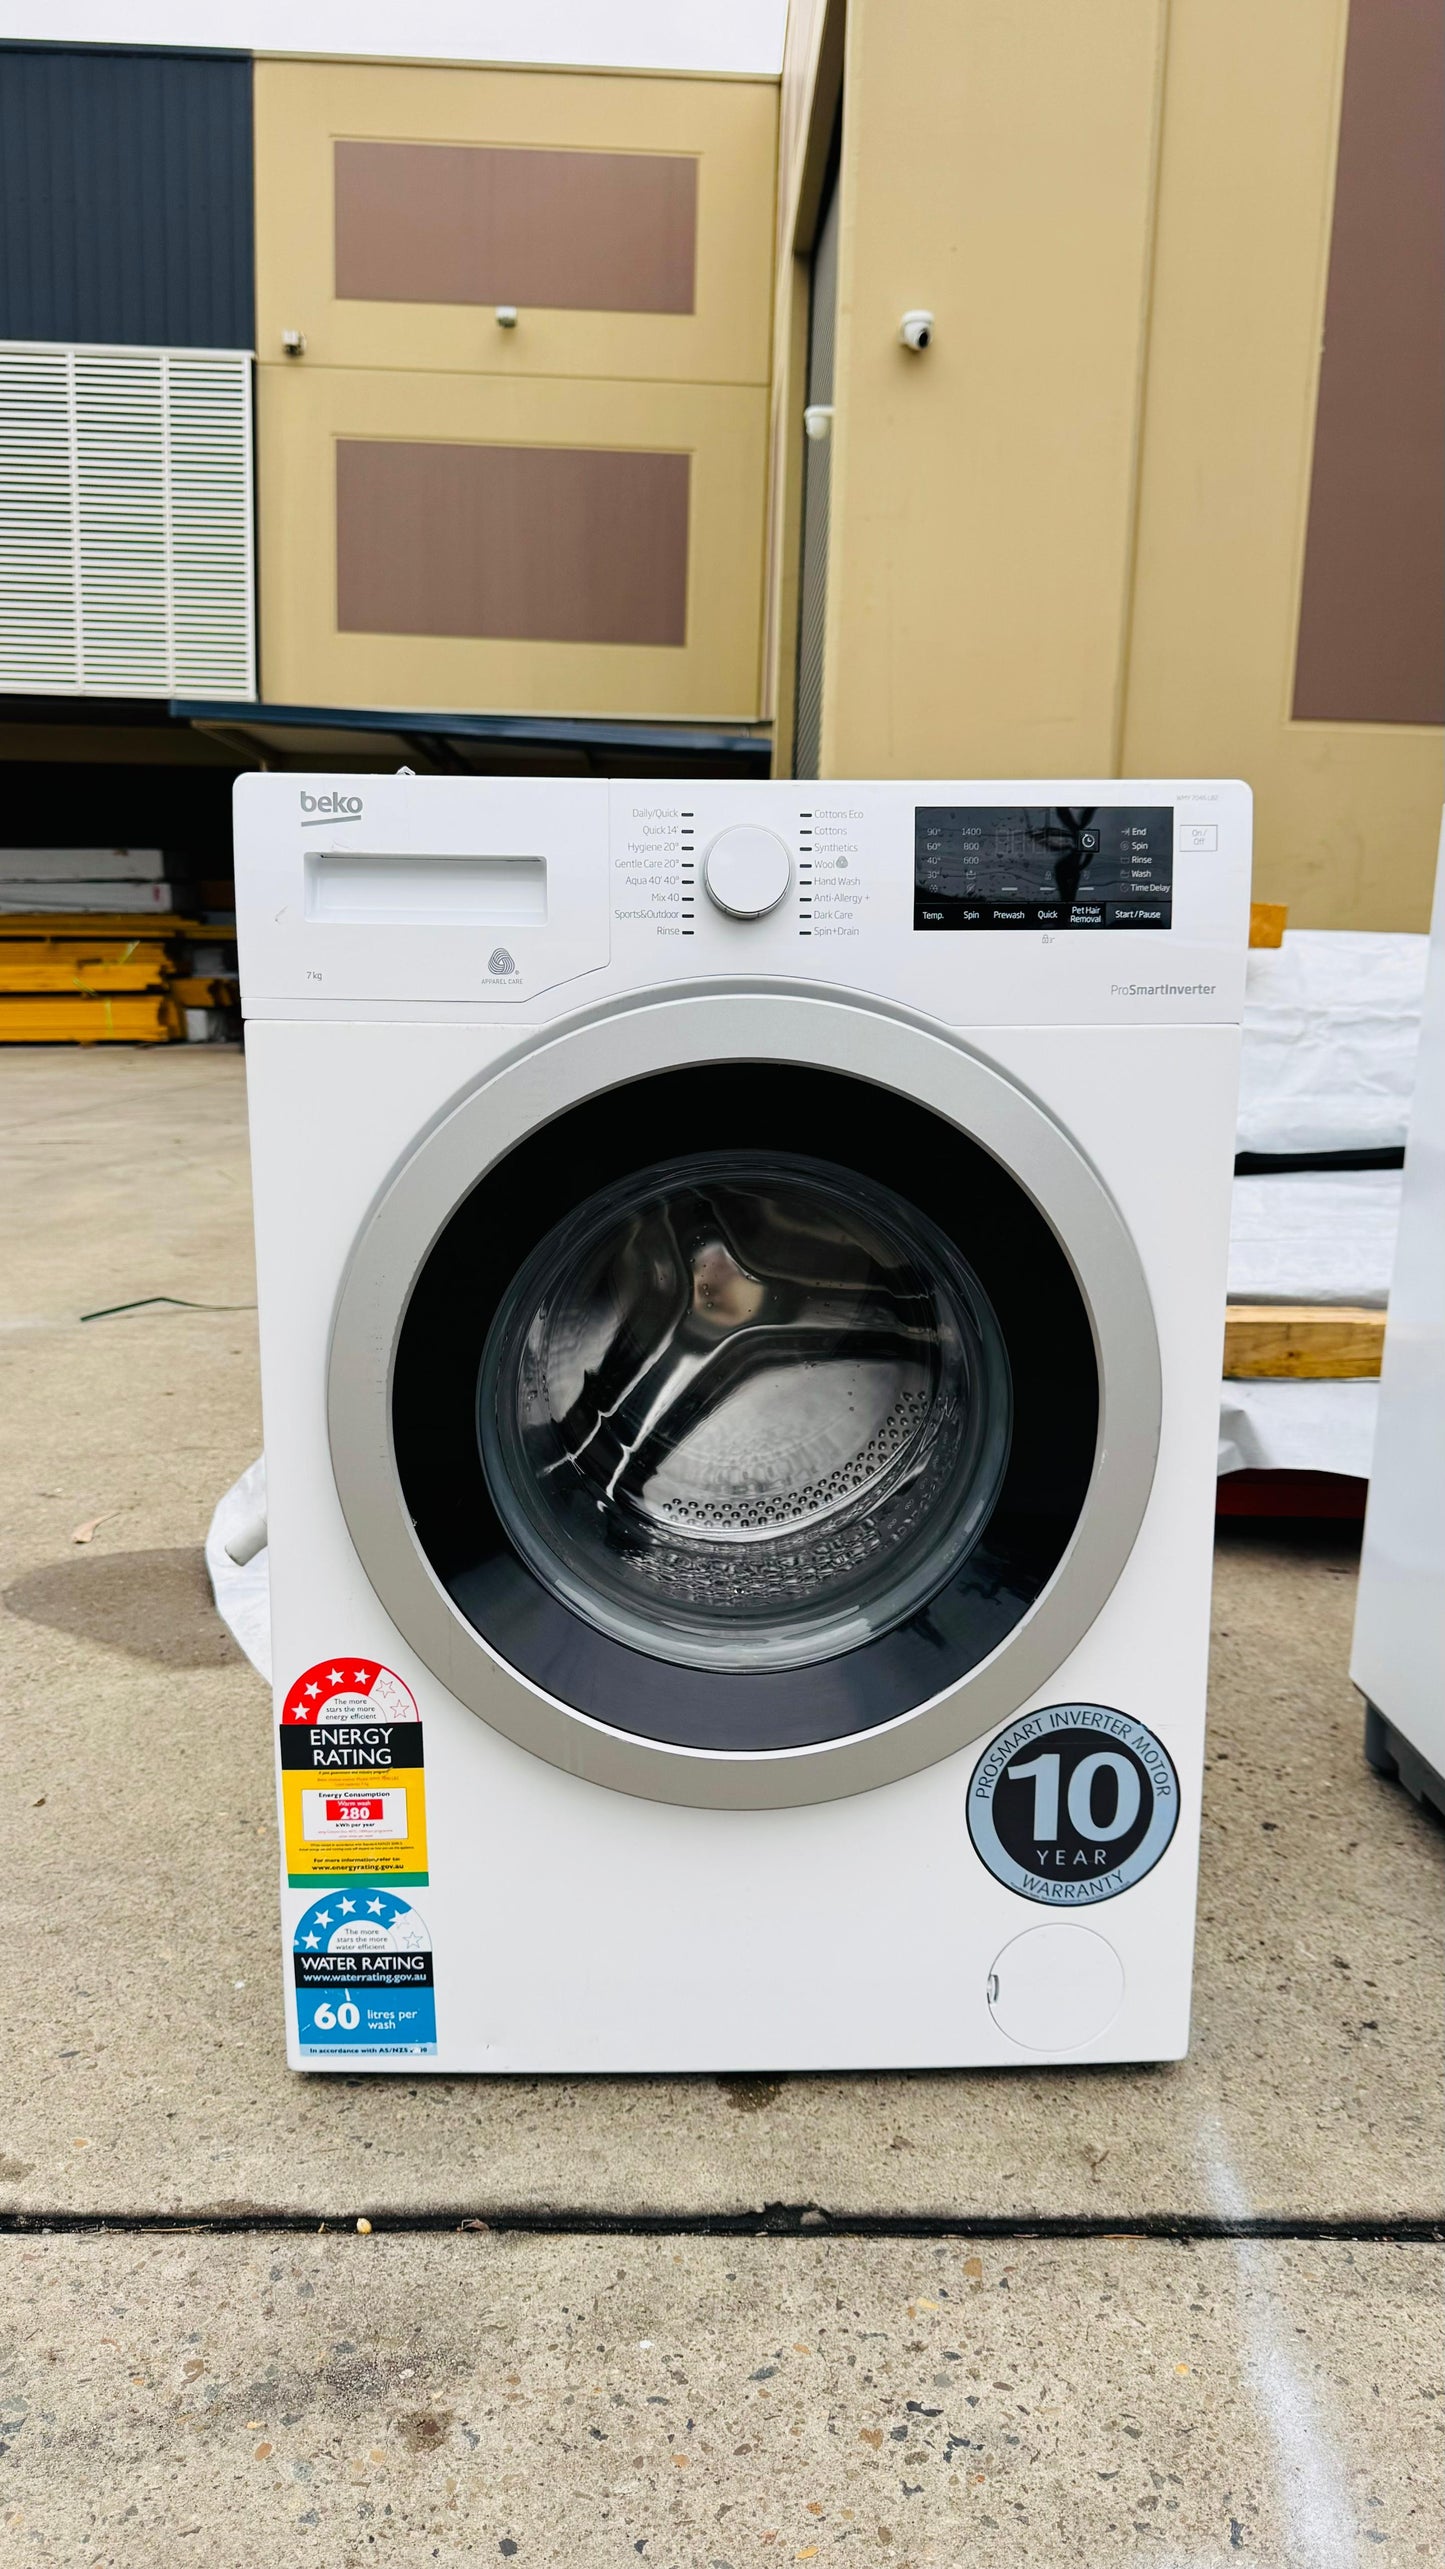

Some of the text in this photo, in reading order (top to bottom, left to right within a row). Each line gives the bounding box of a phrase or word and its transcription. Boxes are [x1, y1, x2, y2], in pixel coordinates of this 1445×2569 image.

[300, 791, 363, 814] beko
[632, 809, 678, 819] Daily/Quick
[814, 810, 864, 819] Cottons Eco
[643, 826, 666, 836] Quick
[814, 827, 847, 835] Cottons
[962, 828, 981, 836] 1400
[1132, 828, 1147, 836] End
[628, 842, 662, 853] Hygiene
[814, 843, 858, 853] Synthetics
[1132, 842, 1148, 850] Spin
[615, 860, 642, 868] Gentle
[644, 860, 662, 868] Care
[814, 860, 835, 868] Wool
[1132, 870, 1151, 878] Wash
[626, 876, 647, 886] Aqua
[814, 877, 860, 886] Hand Wash
[1131, 884, 1171, 893] Time Delay
[651, 894, 666, 902] Mix
[814, 894, 862, 904] Anti-Allergy
[615, 910, 679, 920] Sports&Outdoor
[814, 911, 853, 919] Dark Care
[994, 911, 1025, 919] Prewash
[1038, 910, 1058, 920] Quick
[1072, 906, 1101, 914] Pet Hair
[923, 912, 944, 920] Temp.
[964, 911, 979, 920] Spin
[1070, 915, 1101, 923] Removal
[656, 927, 680, 935] Rinse
[814, 927, 859, 937] Spin+Drain
[1111, 984, 1216, 996] ProSmartInverter
[326, 1714, 348, 1722] energy
[310, 1728, 394, 1746] ENERGY
[313, 1748, 392, 1766] RATING
[976, 1710, 1172, 1799] PROSMART INVERTER MOTOR
[1007, 1752, 1141, 1842] 10
[340, 1807, 370, 1820] 280
[1036, 1850, 1107, 1866] YEAR
[312, 1864, 404, 1872] www.energyrating.gov.au
[1023, 1869, 1123, 1898] WARRANTY
[301, 1956, 425, 1971] WATER RATING
[303, 1973, 427, 1983] www.waterrating.gov.au
[314, 2002, 360, 2030] 60
[367, 2009, 418, 2022] litres per
[368, 2019, 396, 2030] wash
